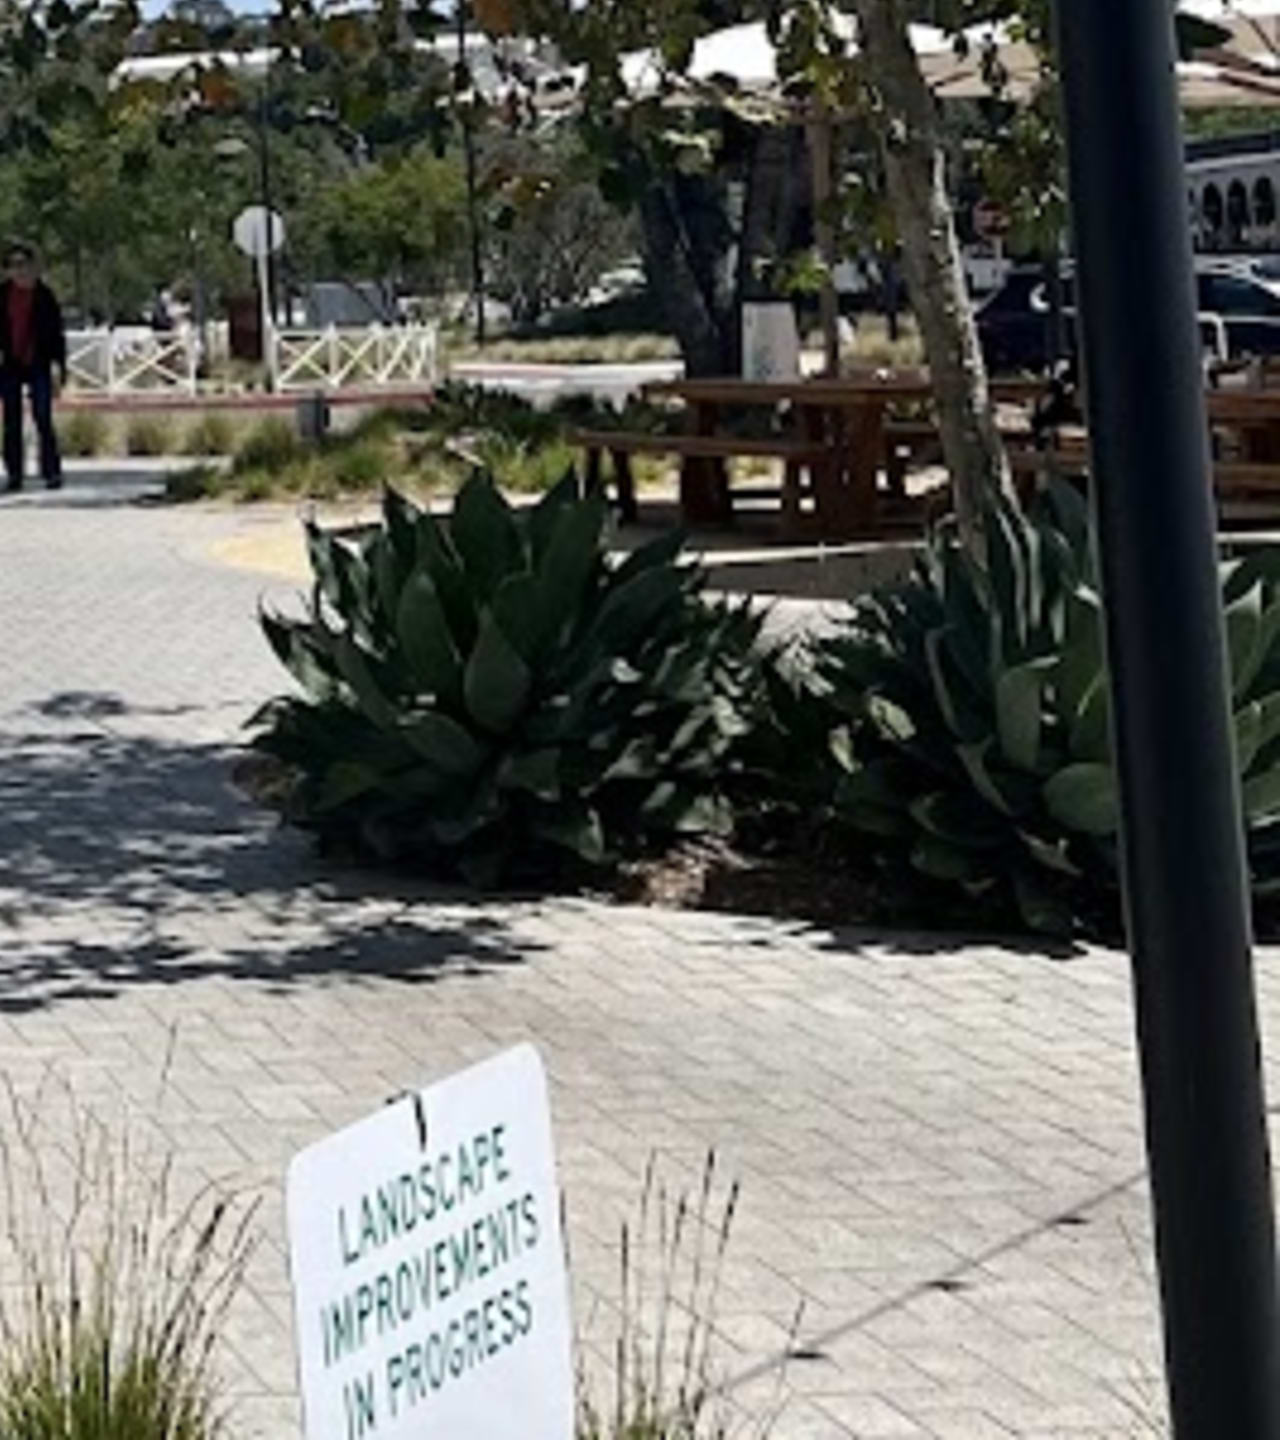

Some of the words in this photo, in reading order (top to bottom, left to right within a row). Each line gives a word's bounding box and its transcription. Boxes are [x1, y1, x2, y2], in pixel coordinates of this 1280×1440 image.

[339, 1124, 510, 1266] LANDSCAPE
[321, 1192, 539, 1368] IMPROVEMENTS
[343, 1369, 377, 1440] IN
[385, 1279, 534, 1417] PROGRESS
